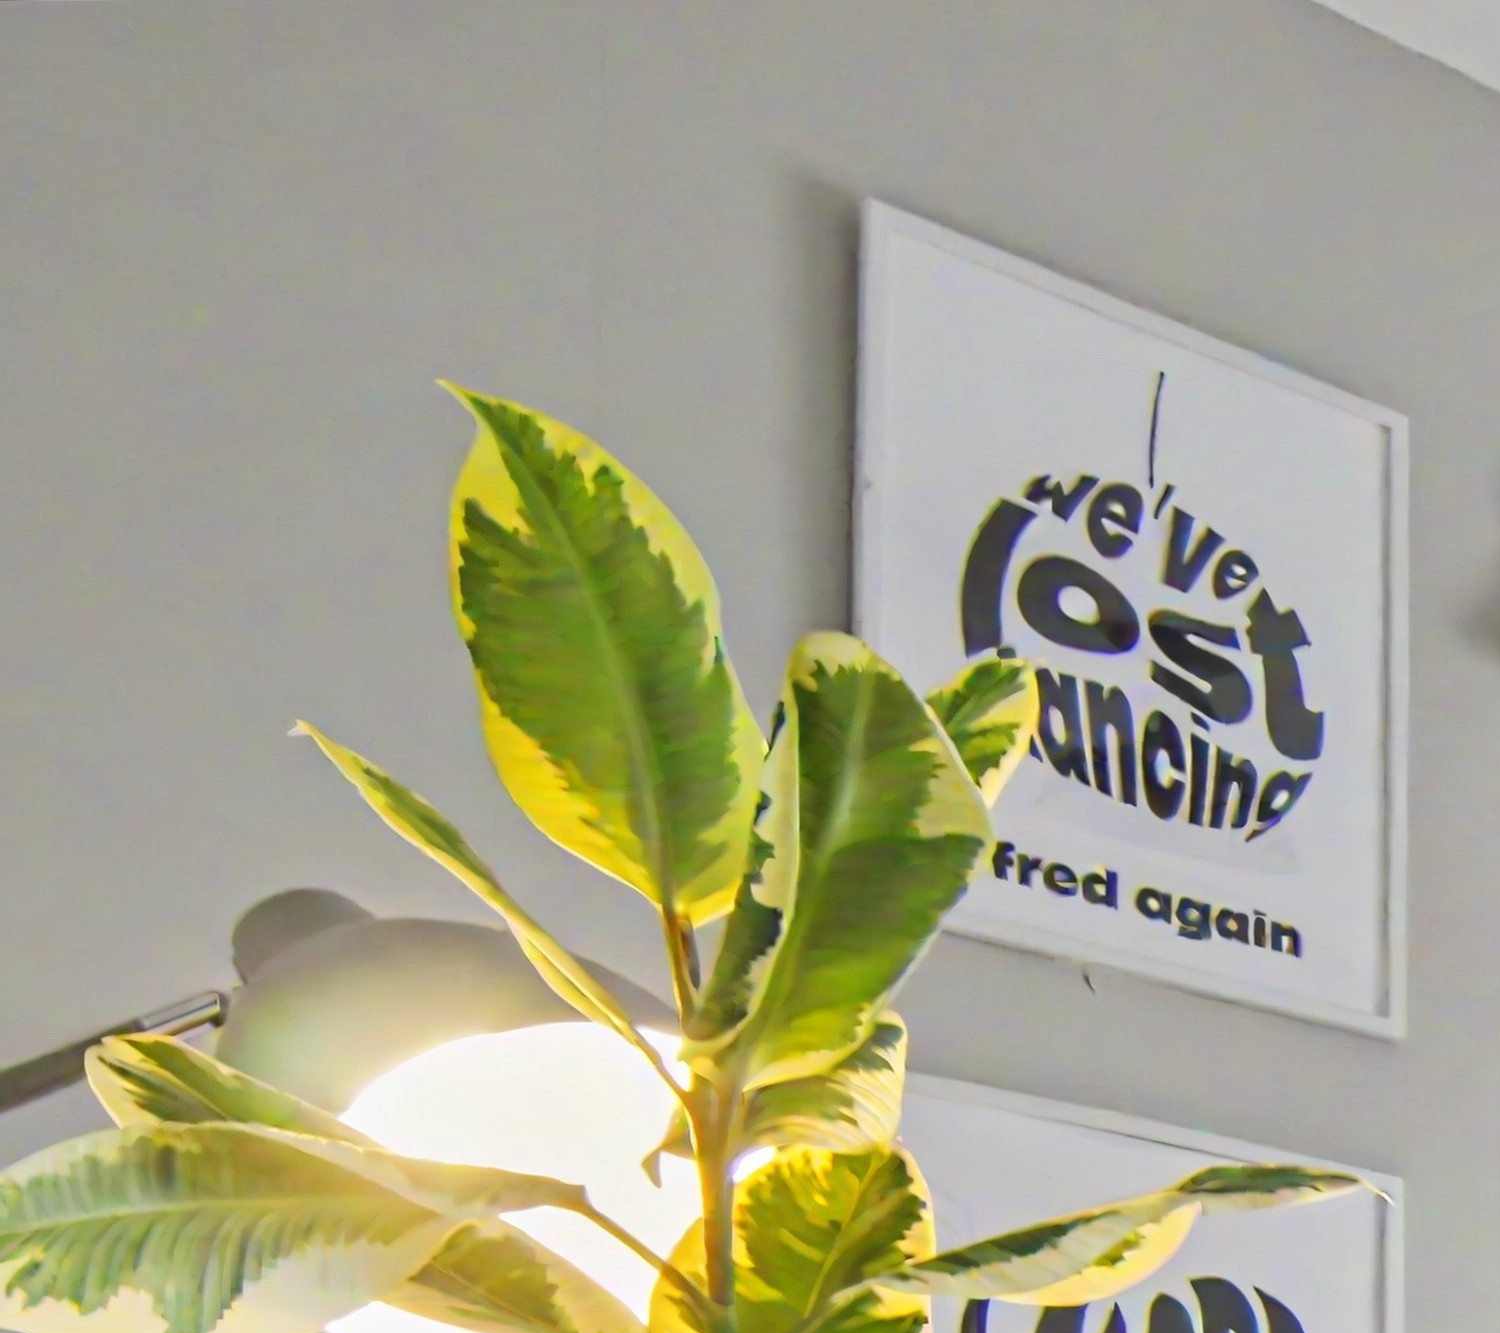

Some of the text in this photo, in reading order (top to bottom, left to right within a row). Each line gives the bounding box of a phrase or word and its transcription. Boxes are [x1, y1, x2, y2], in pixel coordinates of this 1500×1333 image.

[1023, 474, 1260, 600] we've
[961, 498, 1325, 761] lost
[996, 645, 1314, 843] ancing
[991, 841, 1303, 958] fred again
